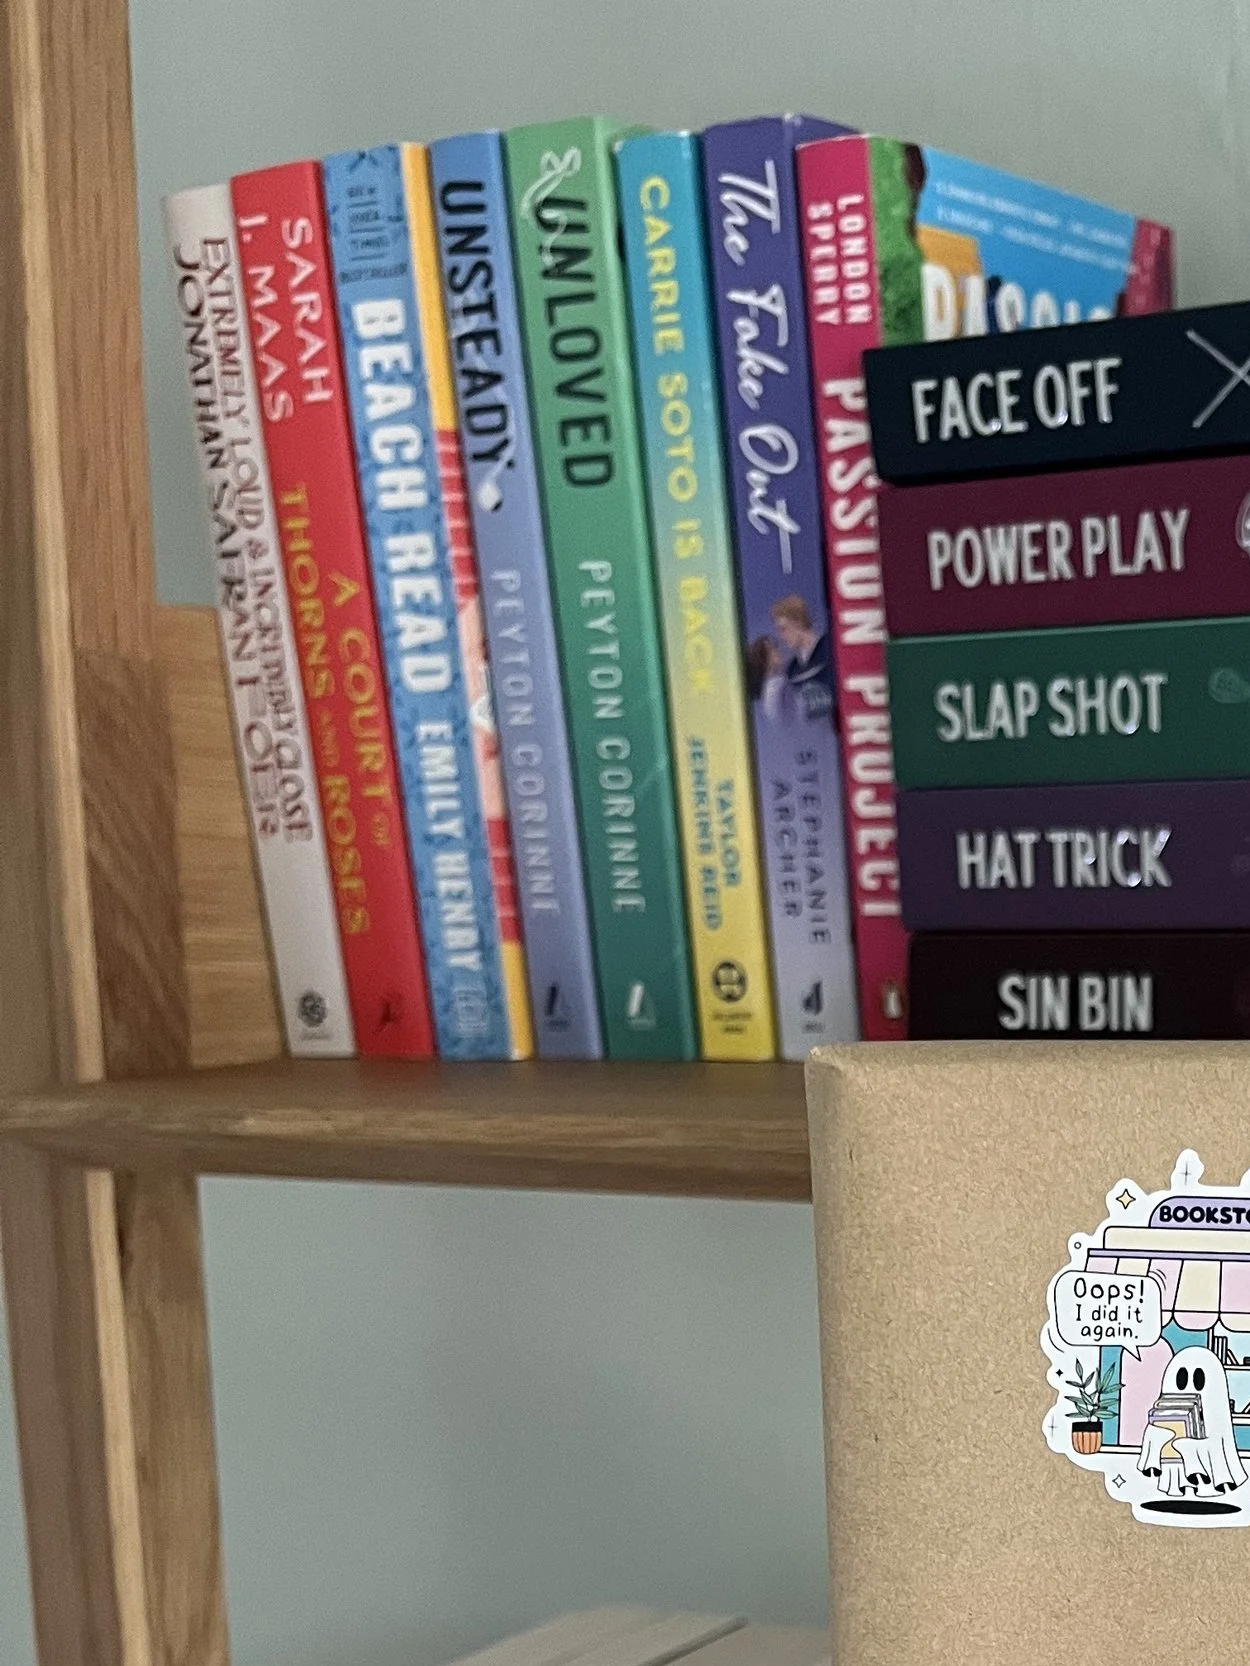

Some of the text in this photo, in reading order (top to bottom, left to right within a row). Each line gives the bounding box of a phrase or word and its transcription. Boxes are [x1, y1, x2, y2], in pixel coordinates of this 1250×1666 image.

[281, 217, 333, 403] SARAH
[439, 180, 514, 470] UNSTEADY
[806, 199, 841, 326] SPERRY
[837, 194, 872, 325] LONDON
[203, 237, 249, 428] EXTREMELY
[227, 438, 264, 528] LOUD
[247, 265, 295, 423] MAAS
[351, 299, 430, 511] BEACH
[535, 196, 616, 489] UNLOVED
[719, 158, 800, 575] The Fake Out
[911, 357, 1122, 444] FACE OFF
[640, 175, 716, 696] CARRIE SOTO IS BACK
[174, 243, 279, 839] JONATHAN SAFRAN FOER
[331, 570, 361, 605] A
[928, 509, 1189, 591] POWER PLAY
[384, 533, 451, 693] READ
[279, 483, 334, 699] THORNS
[322, 775, 371, 936] ROSES
[338, 629, 391, 800] COURT
[490, 570, 560, 912] PEYTON CORINNE
[578, 561, 646, 914] PEYTON CORINNE
[935, 673, 1169, 742] SLAP SHOT
[415, 720, 466, 839] EMILY
[687, 737, 715, 859] JENKINS
[715, 779, 741, 887] TAYLOR
[794, 751, 832, 945] STEPHANIE
[433, 851, 484, 972] HENRY
[771, 780, 800, 918] ARCHER
[956, 828, 1172, 890] HAT TRICK
[998, 974, 1154, 1033] SIN BIN
[1073, 1277, 1145, 1304] Oops!
[1075, 1304, 1143, 1324] I did it
[1080, 1324, 1139, 1341] again.
